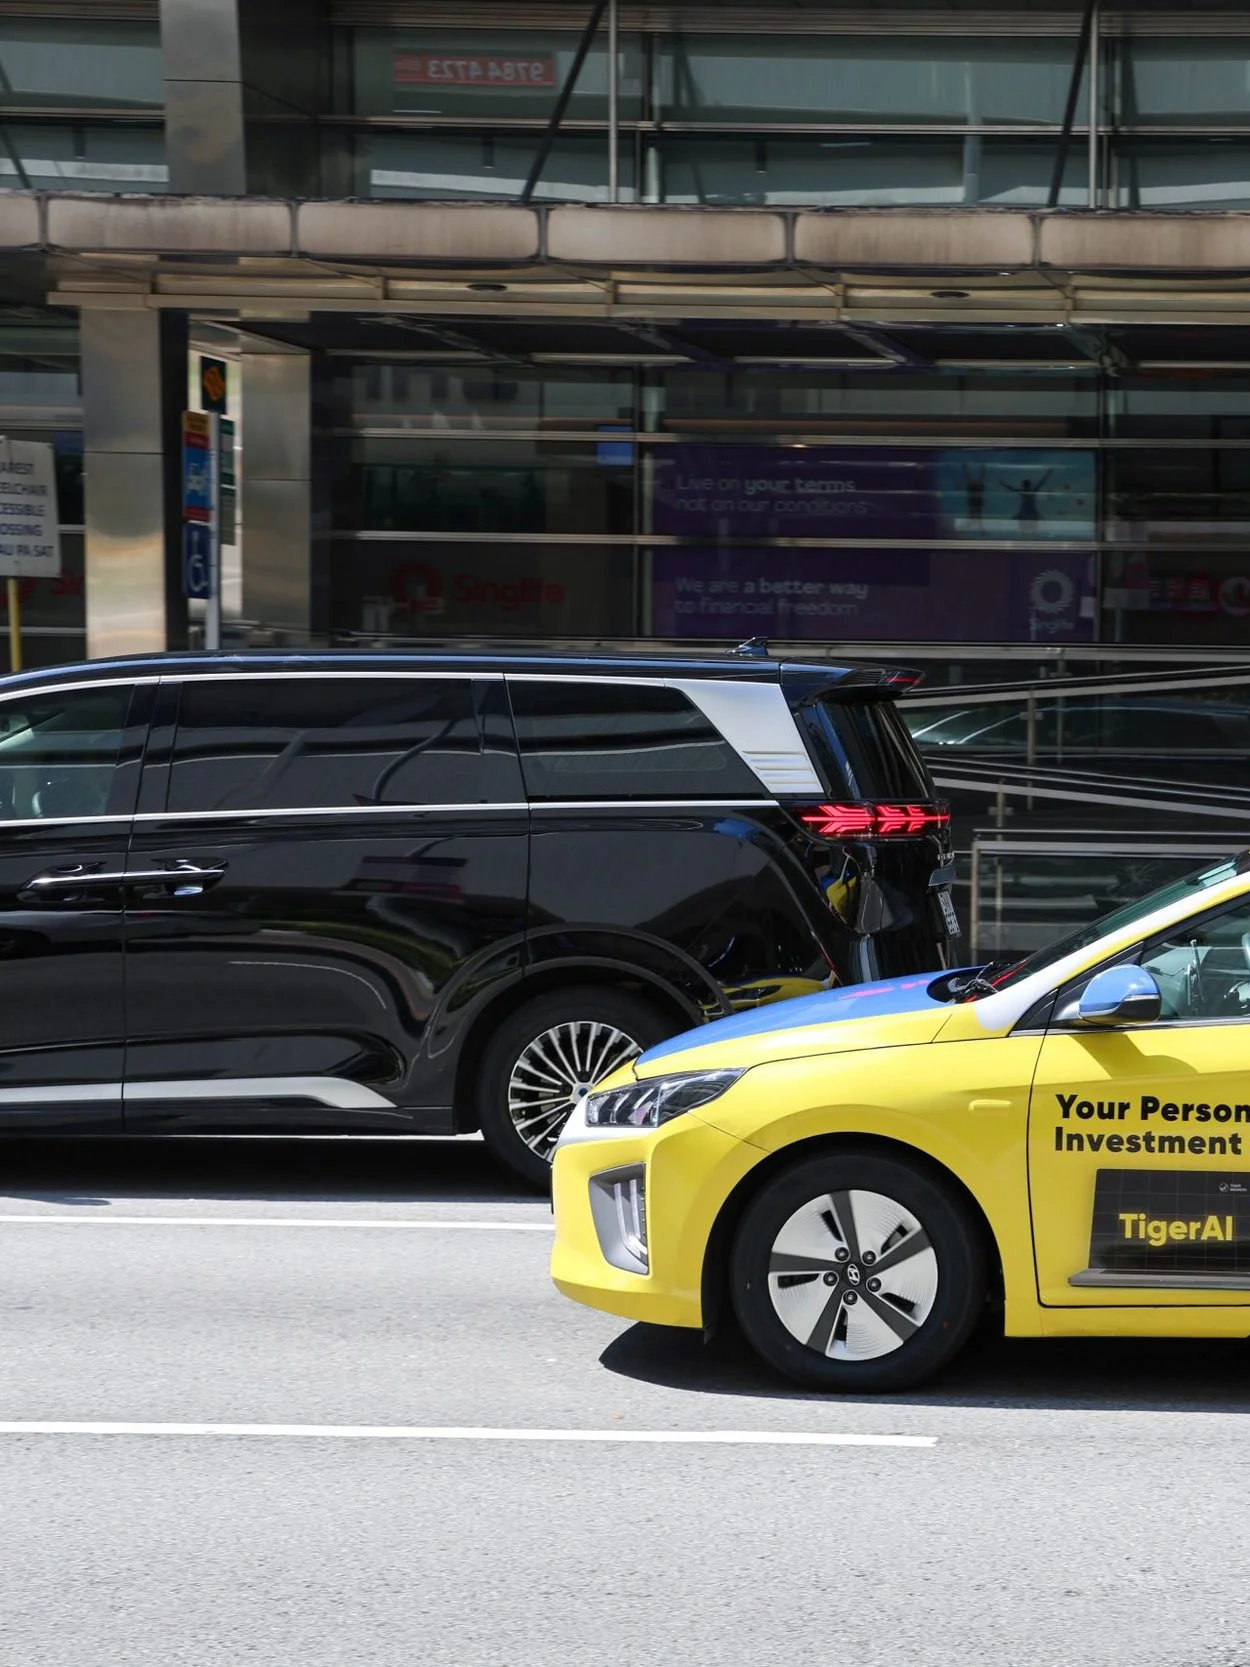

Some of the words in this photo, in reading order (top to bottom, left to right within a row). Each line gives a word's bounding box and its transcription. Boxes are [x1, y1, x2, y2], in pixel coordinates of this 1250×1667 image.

[676, 475, 713, 491] Live
[718, 479, 740, 491] on
[744, 479, 790, 496] your
[794, 478, 856, 493] terms
[675, 499, 707, 512] not
[711, 501, 735, 513] on
[738, 501, 771, 513] our
[774, 499, 868, 514] conditions
[676, 577, 704, 594] We
[707, 581, 738, 594] are
[743, 581, 755, 594] a
[758, 578, 824, 594] better
[828, 582, 869, 599] way
[675, 599, 696, 613] to
[699, 597, 775, 615] financial
[777, 597, 859, 616] freedom
[1055, 1094, 1131, 1121] Your
[1055, 1127, 1242, 1156] Investment
[1118, 1213, 1234, 1247] TigerAI
